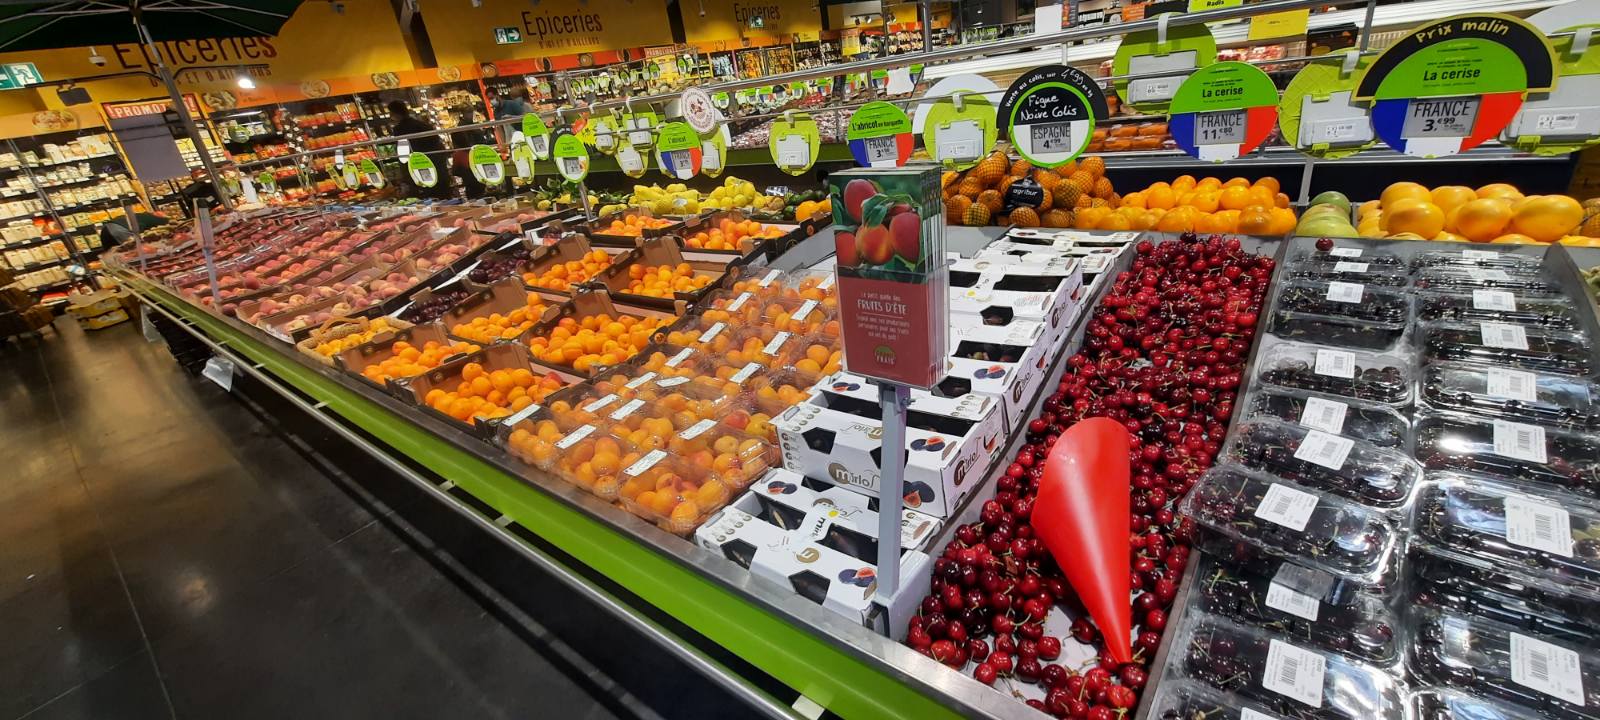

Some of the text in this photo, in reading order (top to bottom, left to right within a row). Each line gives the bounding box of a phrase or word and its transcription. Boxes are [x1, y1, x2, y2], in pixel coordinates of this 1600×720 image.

[521, 9, 603, 40] Epiceries
[1415, 20, 1510, 43] Prix malin
[114, 36, 278, 76] Epiceries
[1423, 67, 1481, 81] La cerise
[1202, 86, 1244, 98] La cerise
[1028, 95, 1060, 109] Figue
[1414, 101, 1472, 118] FRANCE
[1052, 105, 1078, 118] Colis
[1201, 113, 1243, 128] FRANCE
[1033, 125, 1071, 140] ESPAGNE
[857, 299, 883, 313] FRUITS
